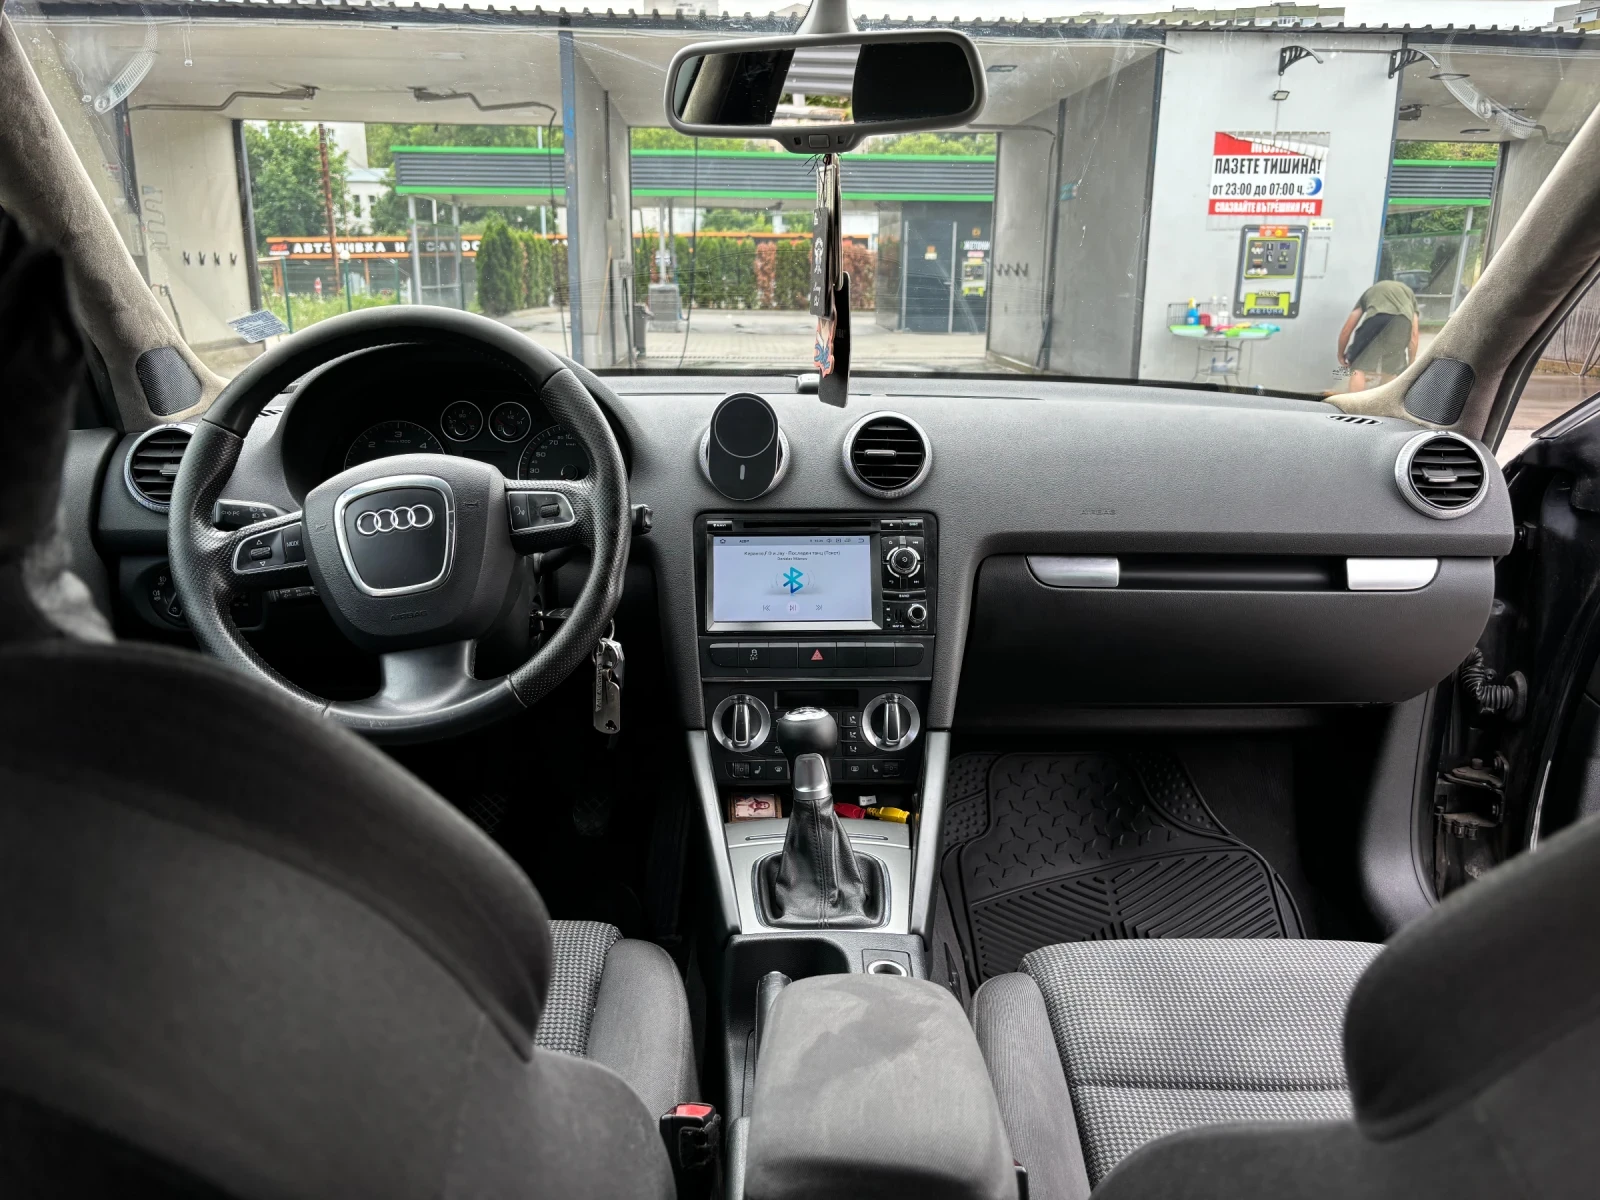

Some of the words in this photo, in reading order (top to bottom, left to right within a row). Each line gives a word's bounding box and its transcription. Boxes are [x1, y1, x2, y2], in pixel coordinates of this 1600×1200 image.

[1214, 158, 1260, 174] ПАЗЕТЕ
[1263, 157, 1322, 175] ТИШИНА!
[1212, 184, 1224, 196] от
[1225, 182, 1252, 196] 23:00
[1253, 183, 1267, 197] до
[1269, 182, 1295, 196] 07:00
[1301, 202, 1316, 215] РЕД
